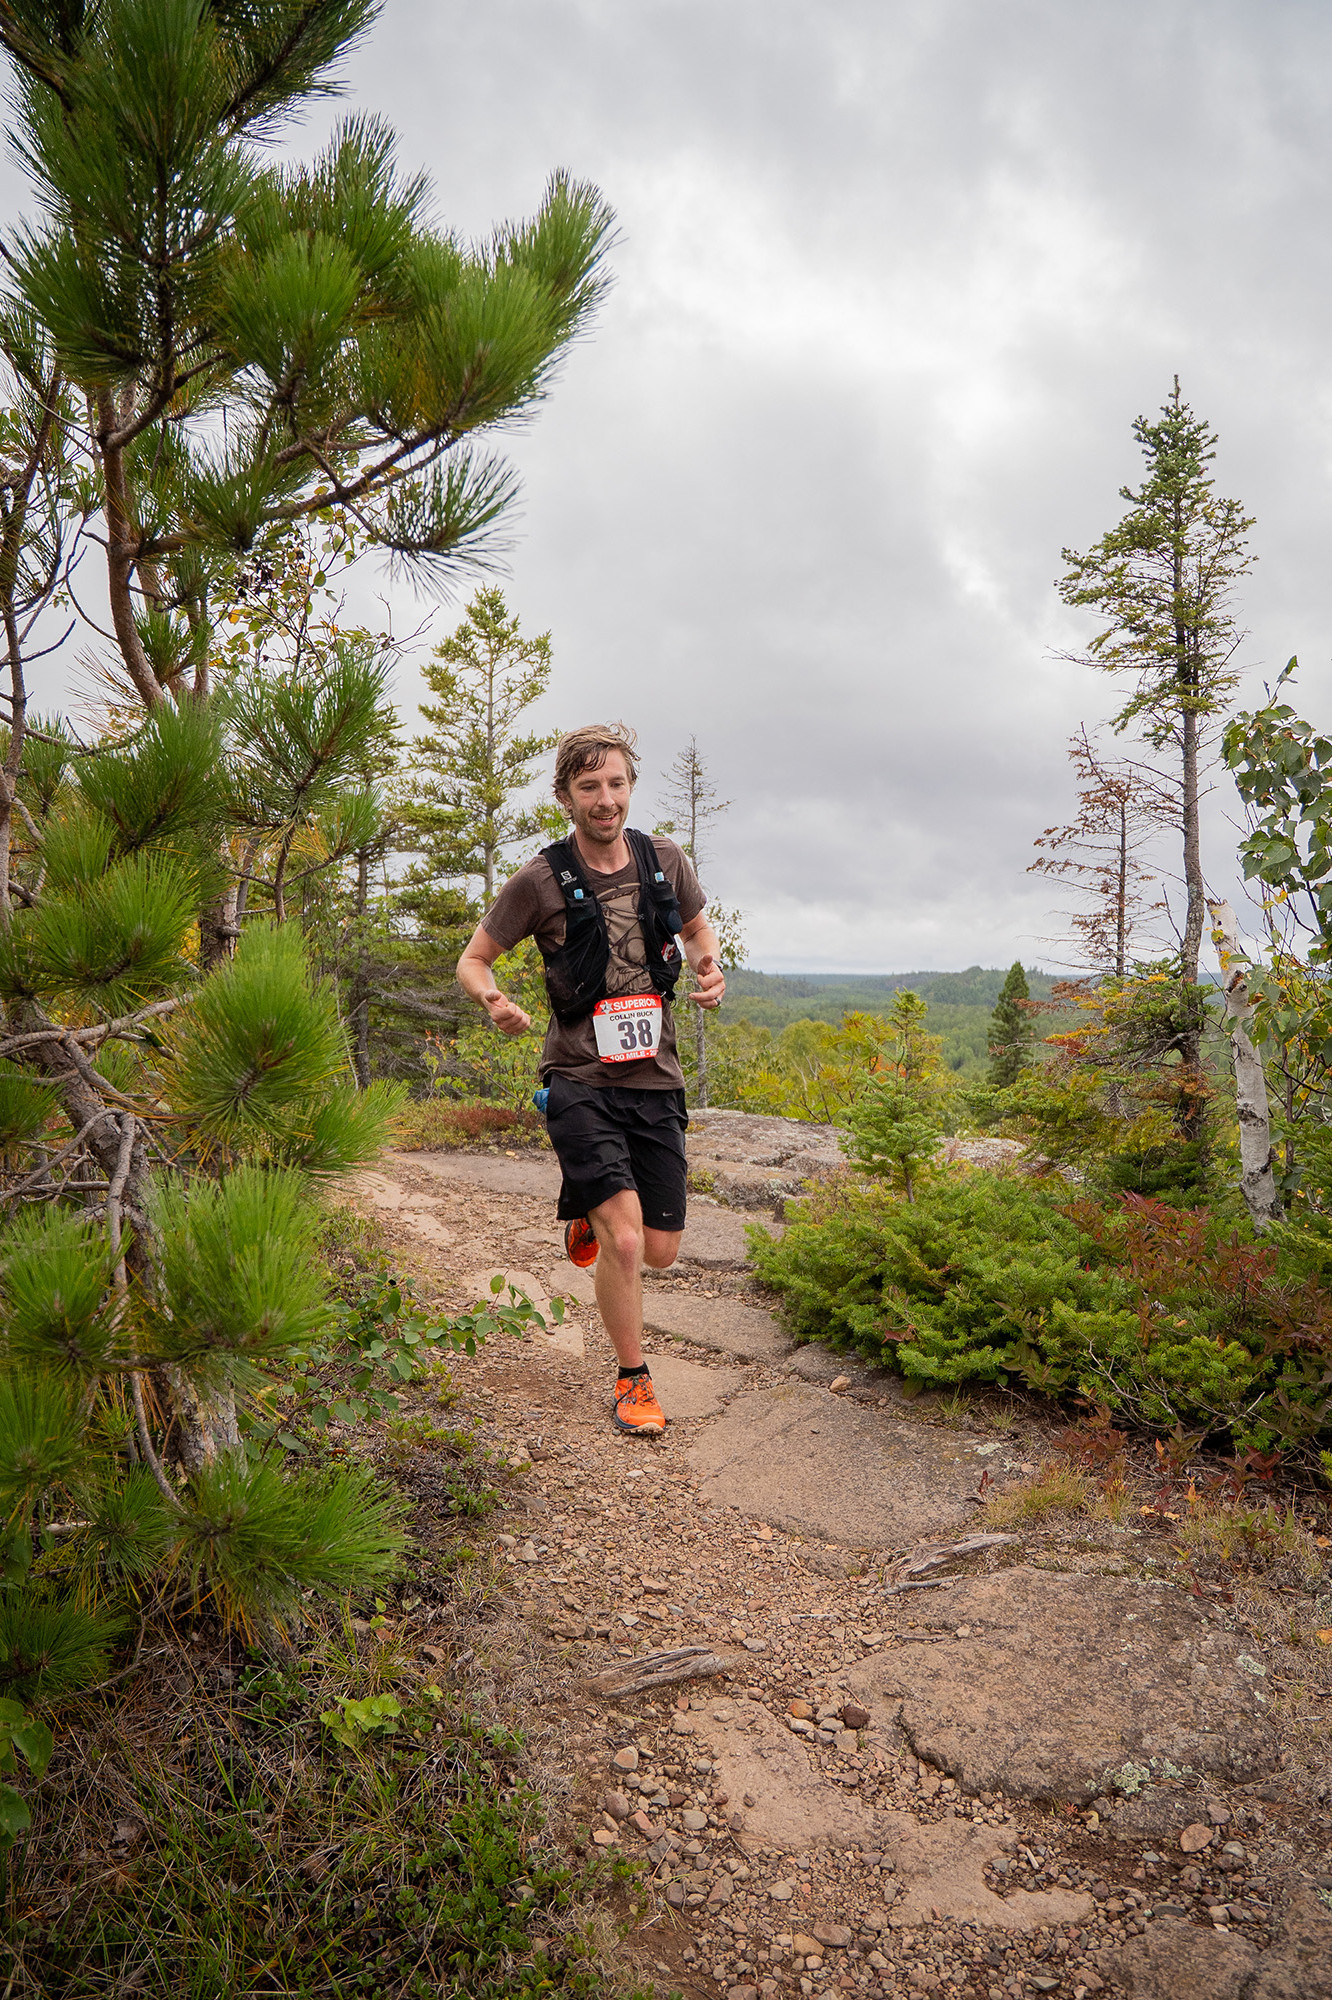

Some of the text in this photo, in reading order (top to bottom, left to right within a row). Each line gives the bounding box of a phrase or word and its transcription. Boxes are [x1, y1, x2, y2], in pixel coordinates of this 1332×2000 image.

[613, 998, 656, 1010] SUPERIOR
[610, 1013, 635, 1021] COLLIN
[618, 1019, 653, 1050] 38
[626, 1051, 645, 1059] MILE
